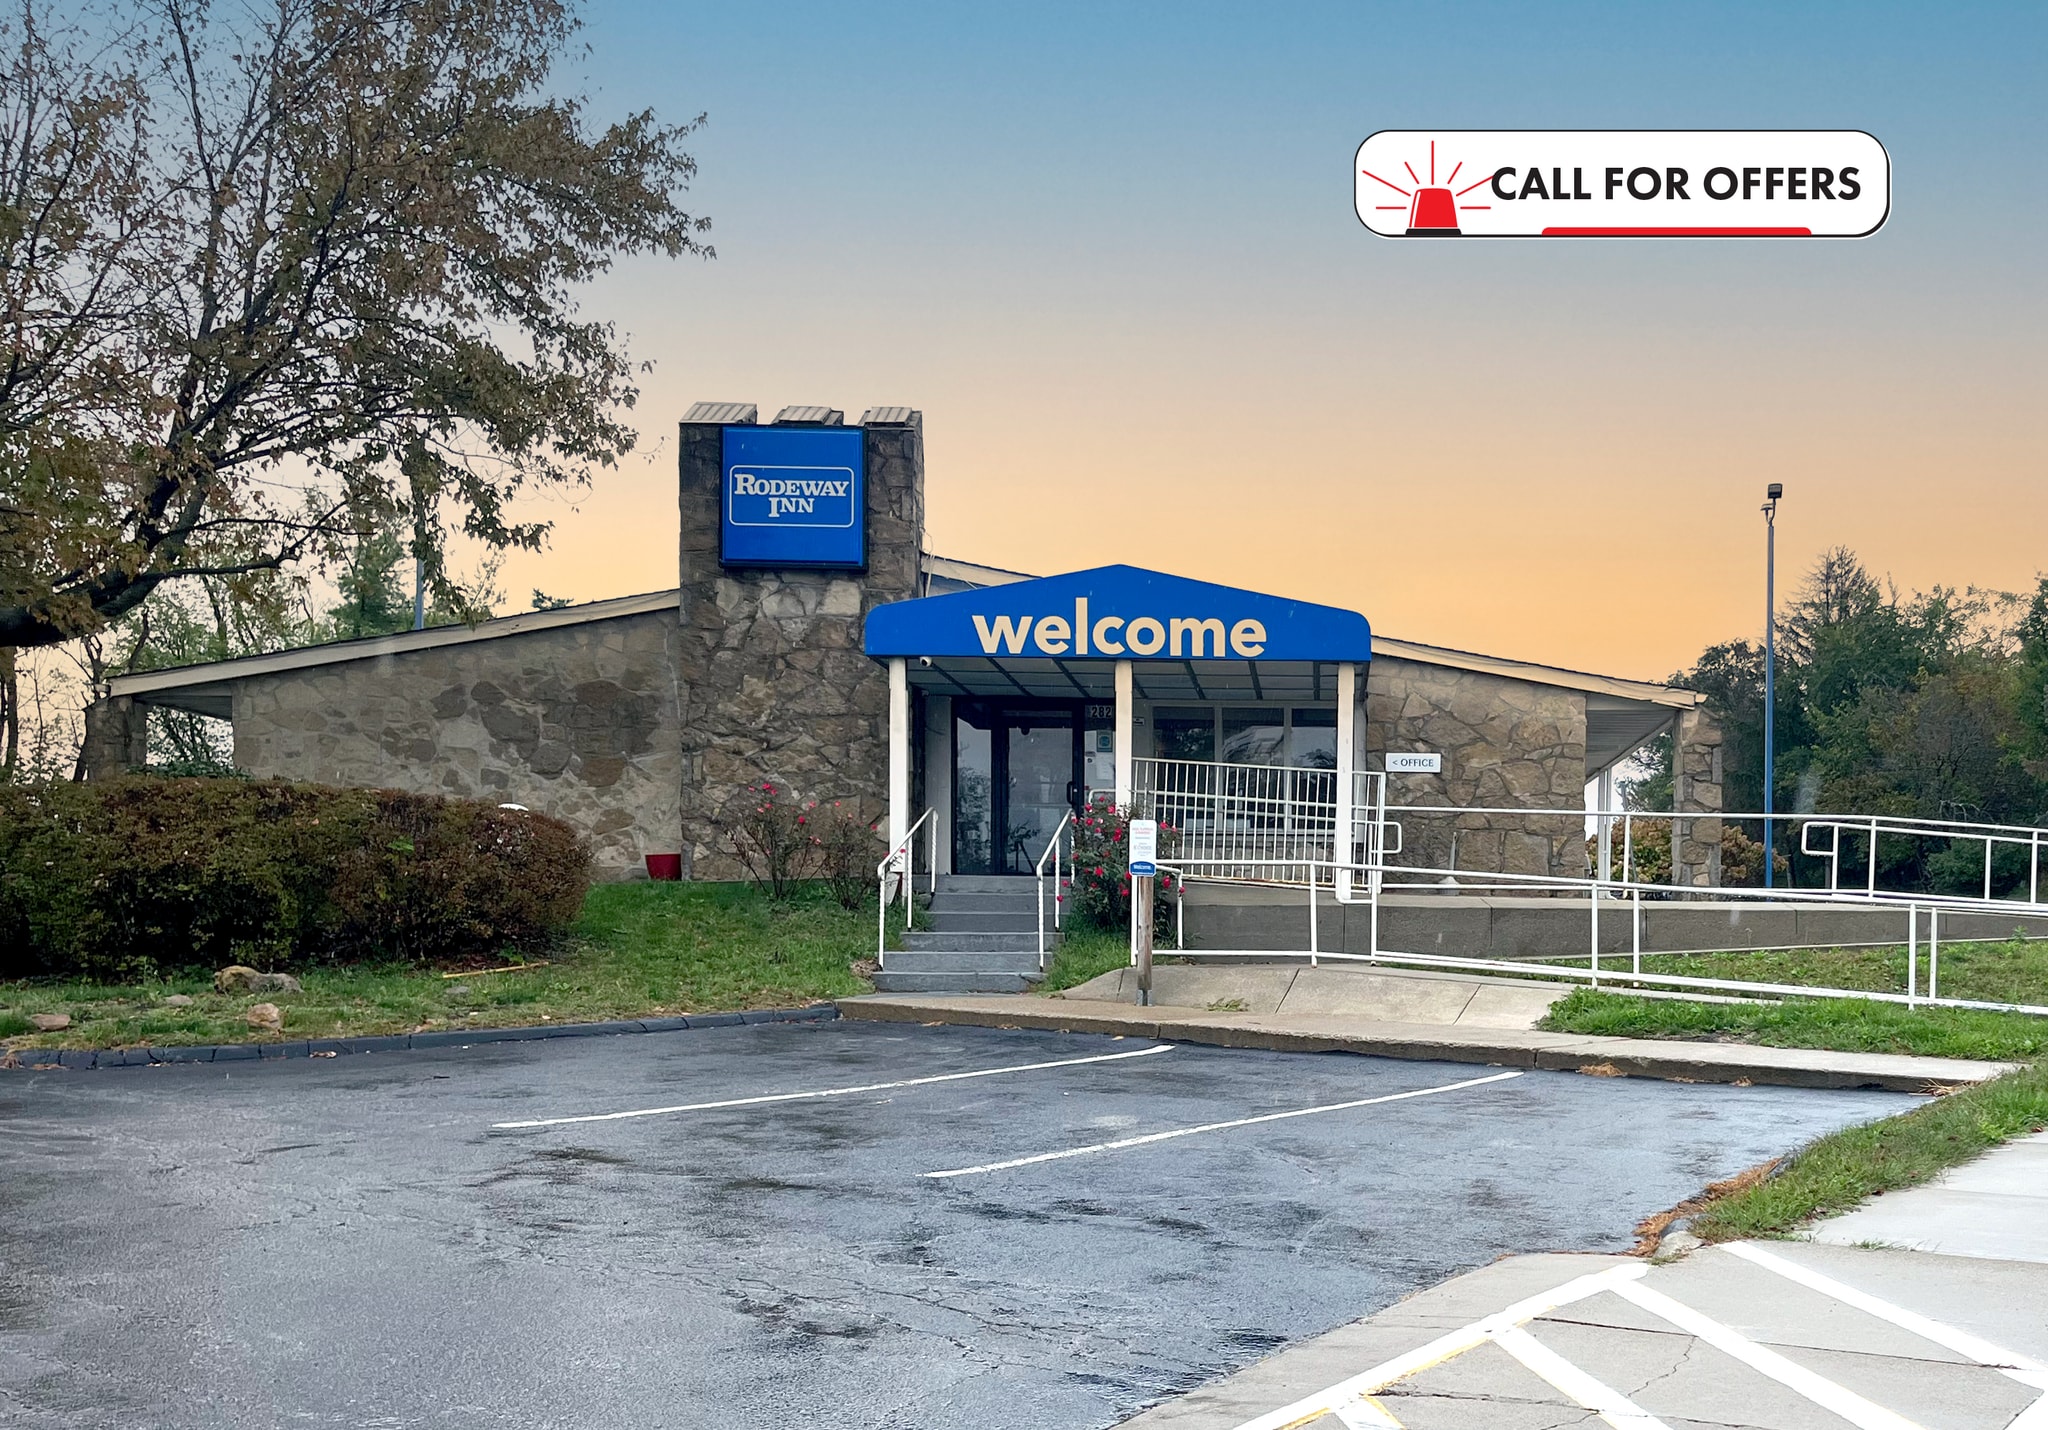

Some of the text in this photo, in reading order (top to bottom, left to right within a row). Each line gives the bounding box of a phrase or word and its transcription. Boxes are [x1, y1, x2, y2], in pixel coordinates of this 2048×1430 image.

[734, 473, 849, 497] RODEWAY
[768, 497, 814, 517] INN
[971, 597, 1267, 657] welcome
[1400, 758, 1434, 767] OFFICE
